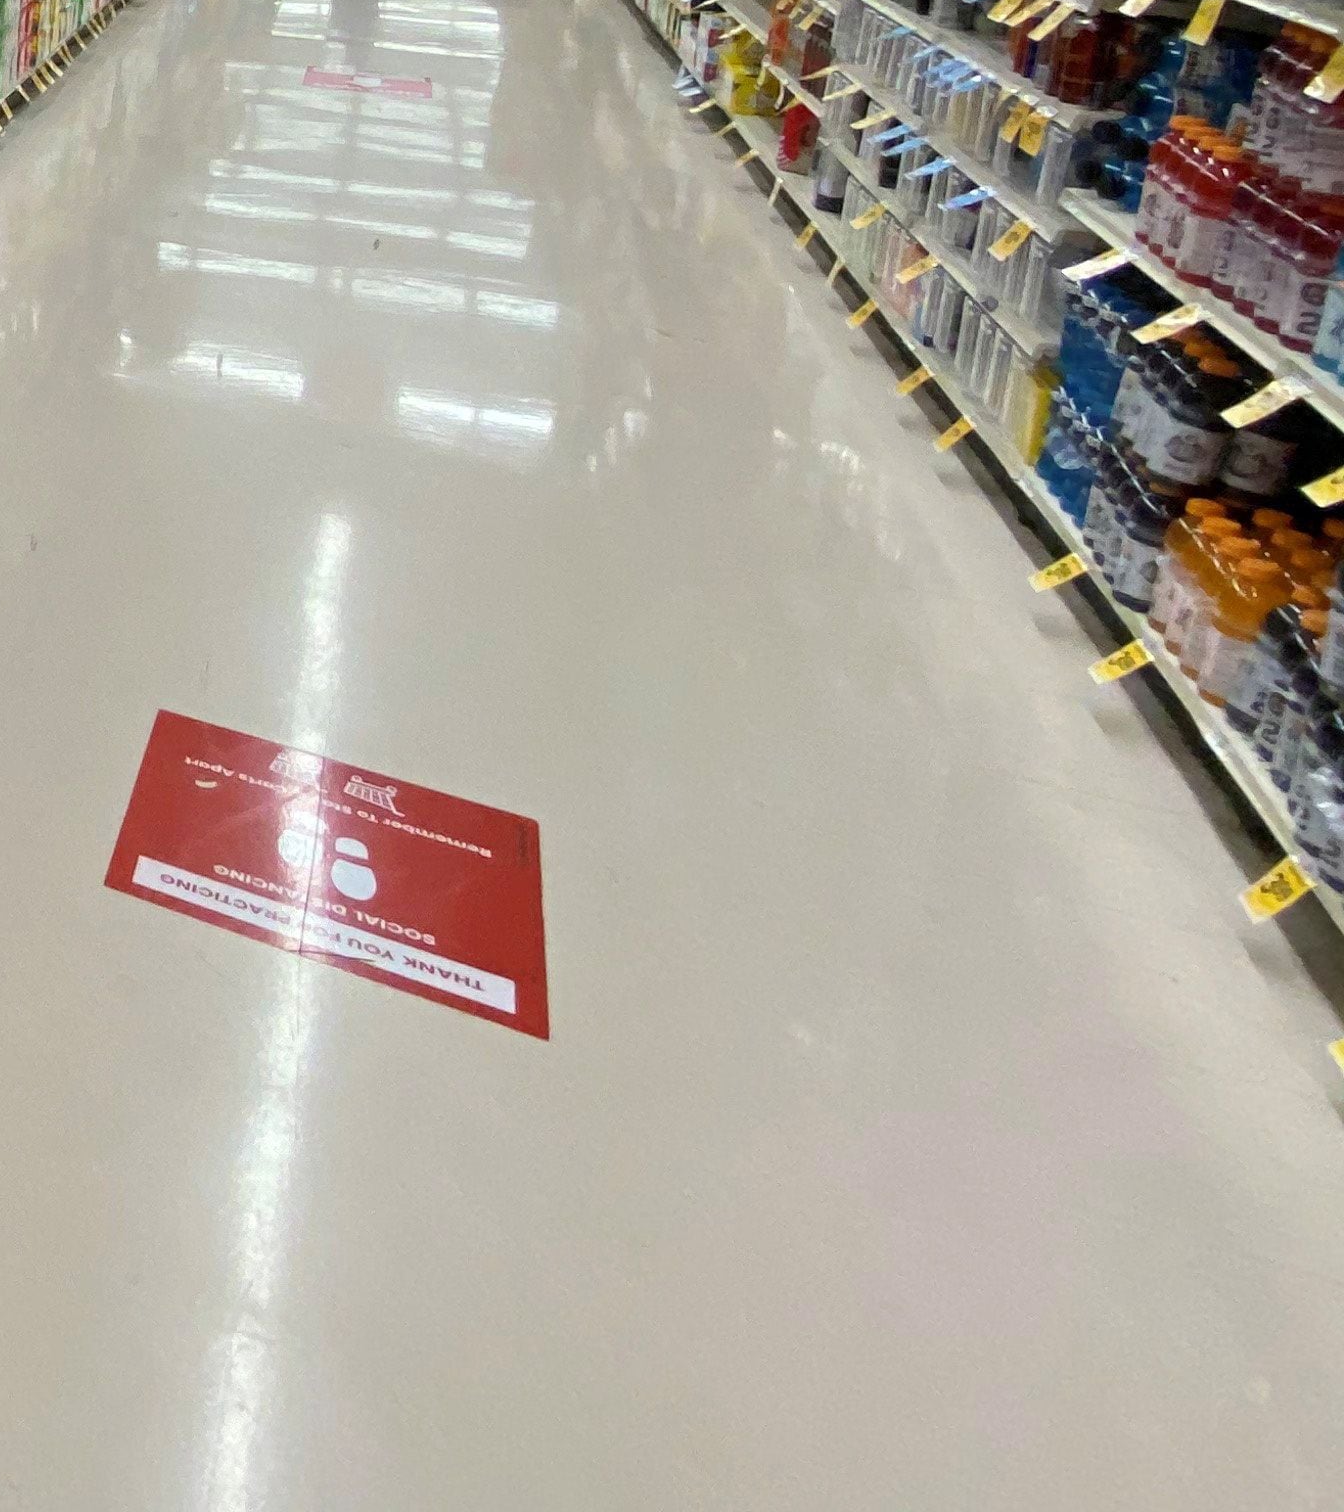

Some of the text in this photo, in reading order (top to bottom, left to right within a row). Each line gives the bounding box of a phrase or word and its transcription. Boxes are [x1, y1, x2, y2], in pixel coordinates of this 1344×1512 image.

[183, 754, 235, 780] Apart
[356, 809, 381, 826] To
[382, 817, 493, 859] Remember
[159, 872, 293, 928] PRACTICING
[355, 911, 436, 947] SOCIAL
[343, 934, 396, 965] YOU
[401, 954, 487, 993] THANK
